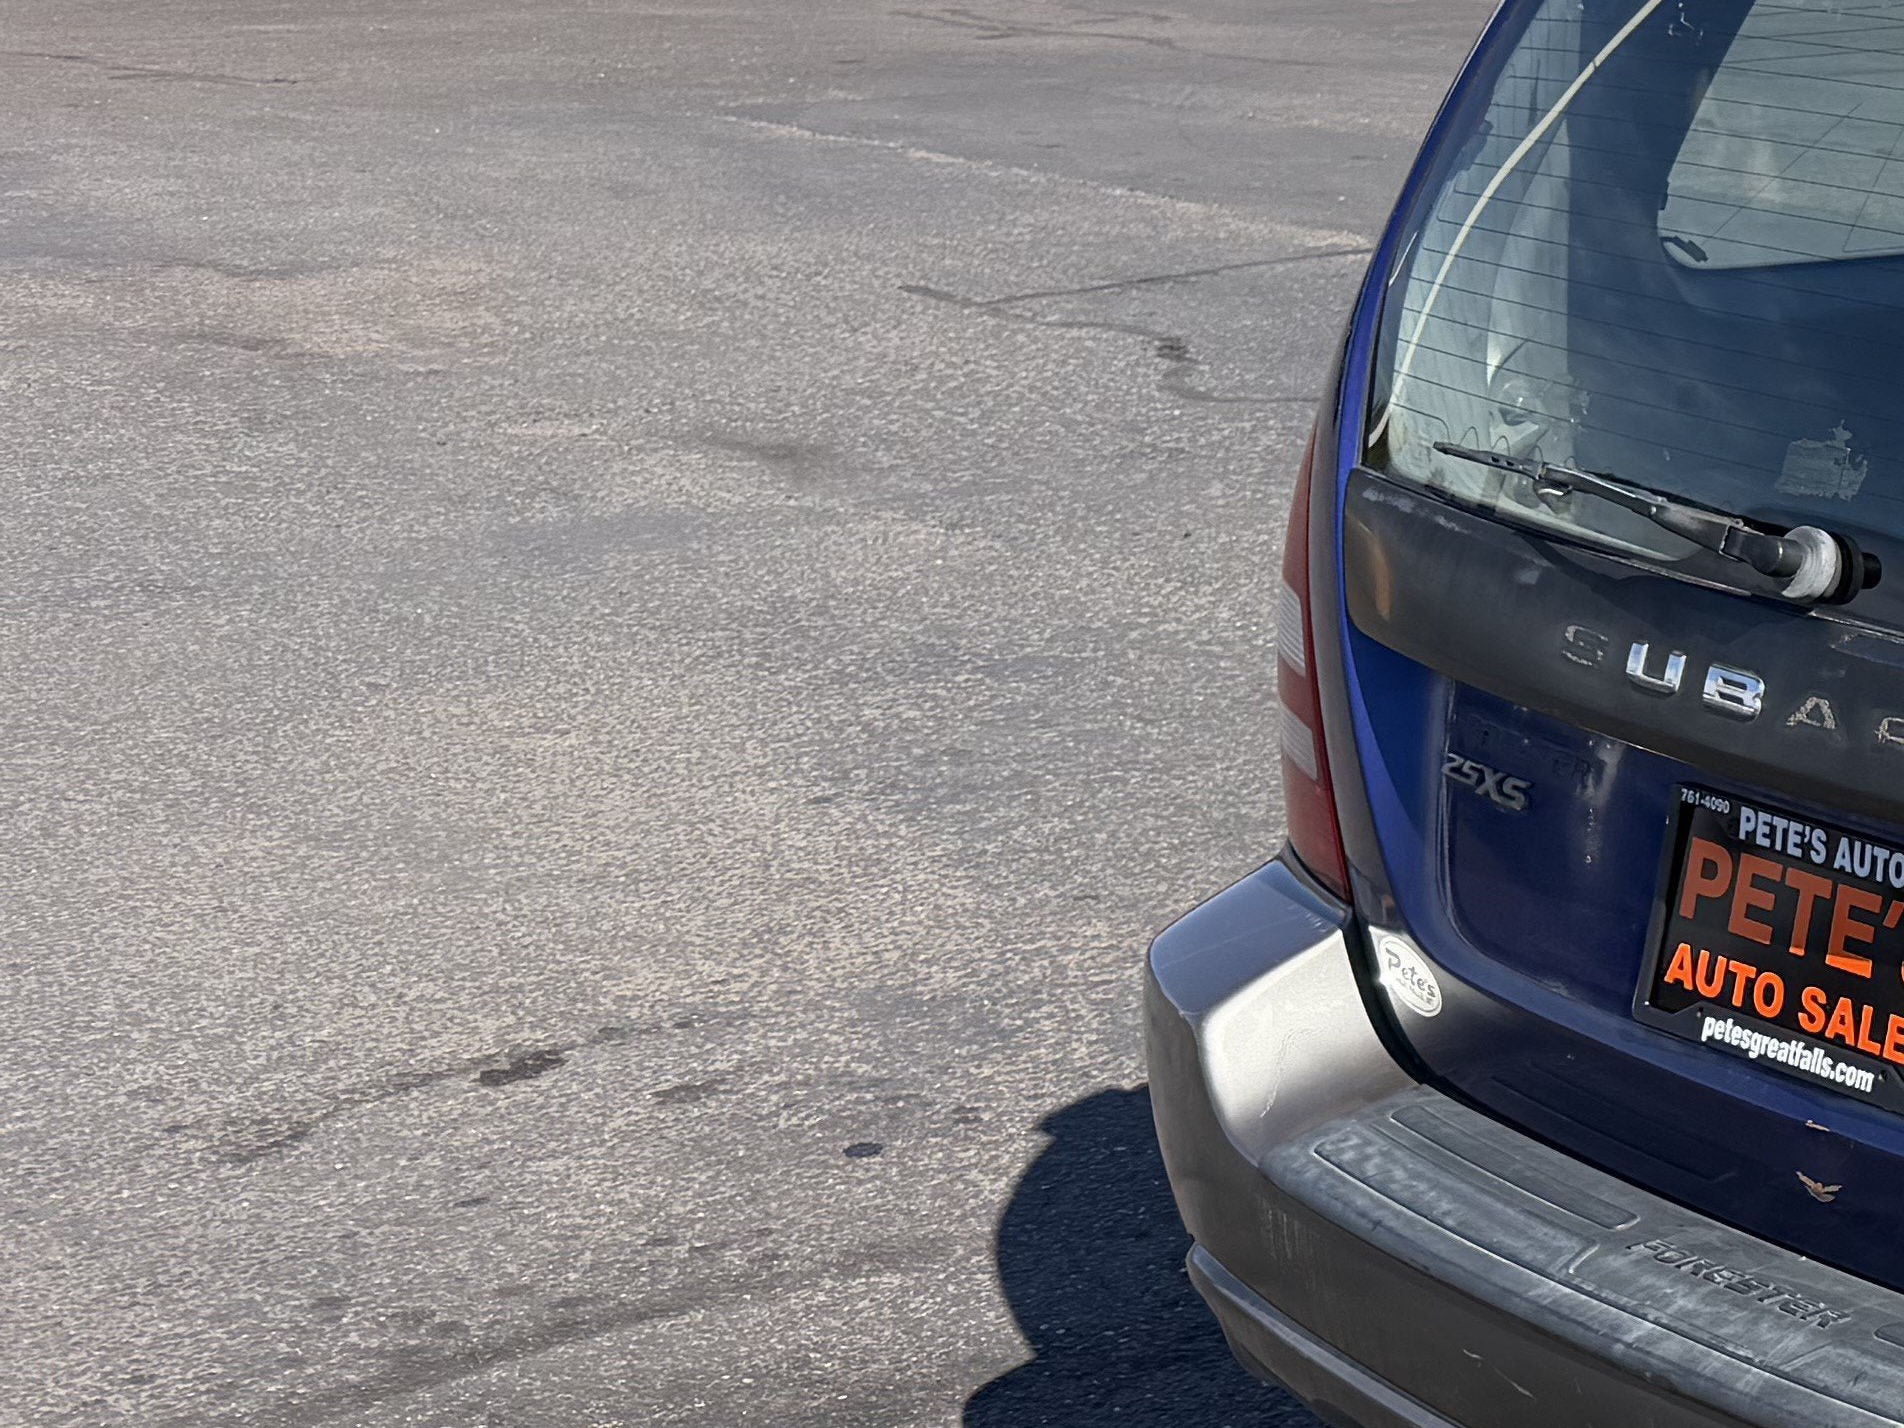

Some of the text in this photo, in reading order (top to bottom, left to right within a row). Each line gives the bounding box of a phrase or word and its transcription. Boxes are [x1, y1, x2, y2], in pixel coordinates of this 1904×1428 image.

[1681, 788, 1730, 815] 761-4090
[1739, 805, 1828, 865] PETE'S
[1664, 943, 1785, 1018] AUTO
[1701, 1015, 1875, 1093] petesgreatfalls.com
[1626, 1239, 1851, 1329] FORESTER
